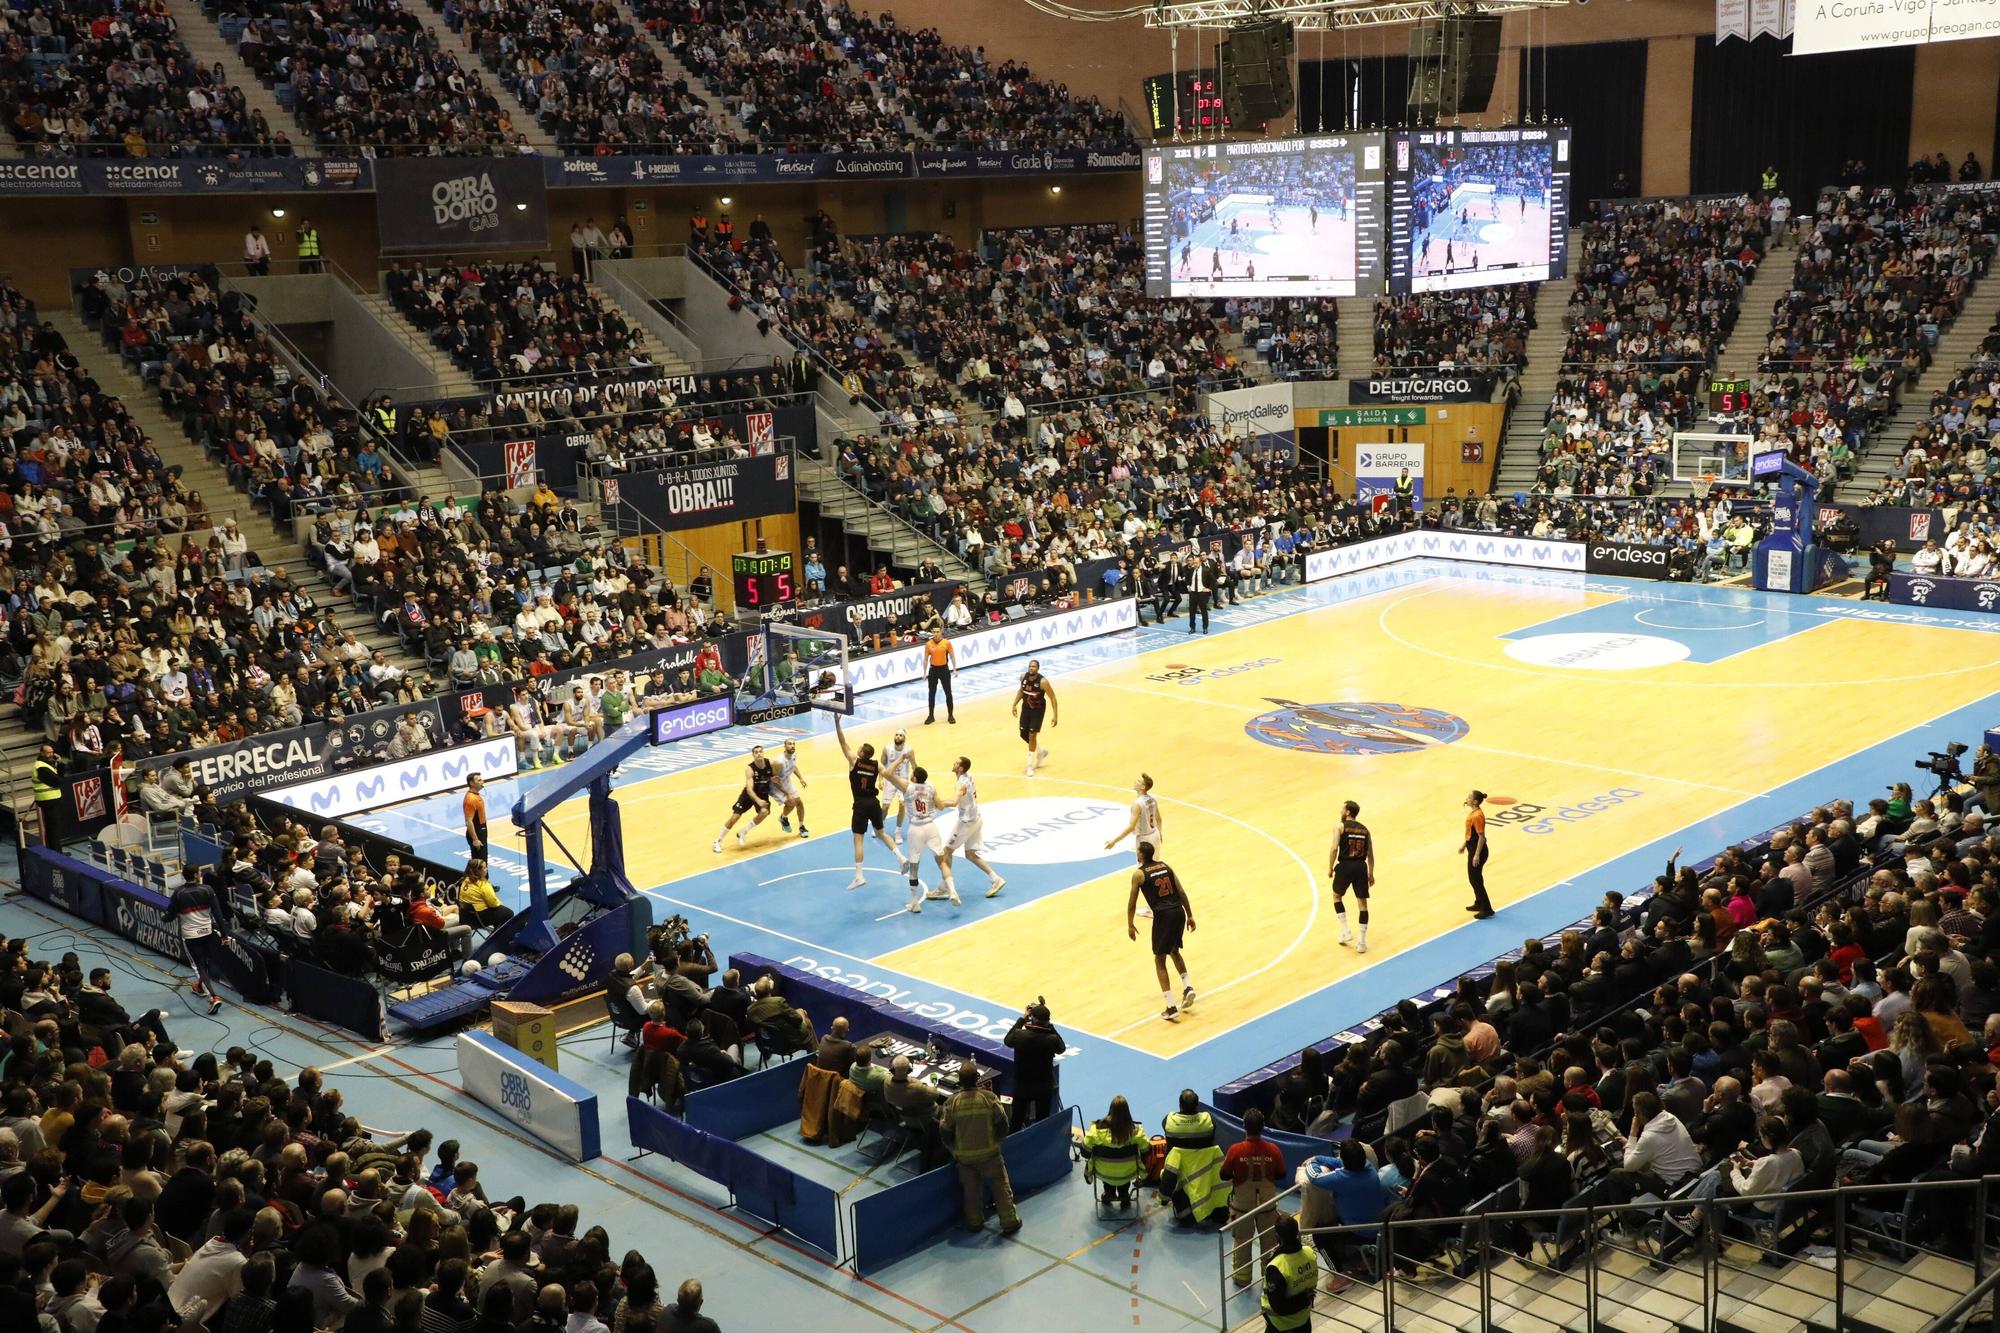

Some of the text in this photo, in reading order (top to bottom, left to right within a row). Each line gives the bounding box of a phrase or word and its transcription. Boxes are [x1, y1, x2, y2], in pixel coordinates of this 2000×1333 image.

[1816, 5, 1827, 20] A
[1831, 1, 1884, 19] Coruña
[1860, 20, 2000, 41] www.grupobreogan.co
[1226, 139, 1339, 156] PARTIDO PATROCINADO POR asisa
[564, 160, 598, 173] Softee
[847, 160, 904, 174] dinahosting
[1011, 154, 1041, 169] Grada
[1087, 151, 1140, 167] #SomosObra
[14, 164, 78, 180] cenor
[121, 165, 180, 180] cenor
[432, 173, 496, 205] OBRA
[433, 194, 498, 225] DOIRO
[1711, 382, 1734, 392] 07:19
[1723, 394, 1732, 411] 5
[1356, 409, 1387, 417] SAIDA
[566, 435, 595, 447] OBRA
[1375, 453, 1407, 461] GRUPO
[1375, 460, 1420, 468] BARREIRO
[1753, 455, 1783, 475] endesa
[668, 477, 735, 514] OBRA!!!
[759, 555, 791, 574] 07:19
[1592, 546, 1667, 566] endesa
[747, 574, 791, 603] 5 5
[1145, 667, 1206, 682] liga
[660, 707, 728, 738] endesa
[750, 707, 796, 726] endesa
[248, 776, 265, 792] del
[267, 764, 325, 788] Profesional
[1522, 788, 1643, 834] endesa
[137, 924, 181, 958] HERACLES
[410, 950, 447, 972] SPALDING
[500, 1070, 531, 1094] OBRA
[501, 1090, 531, 1112] DOIRO
